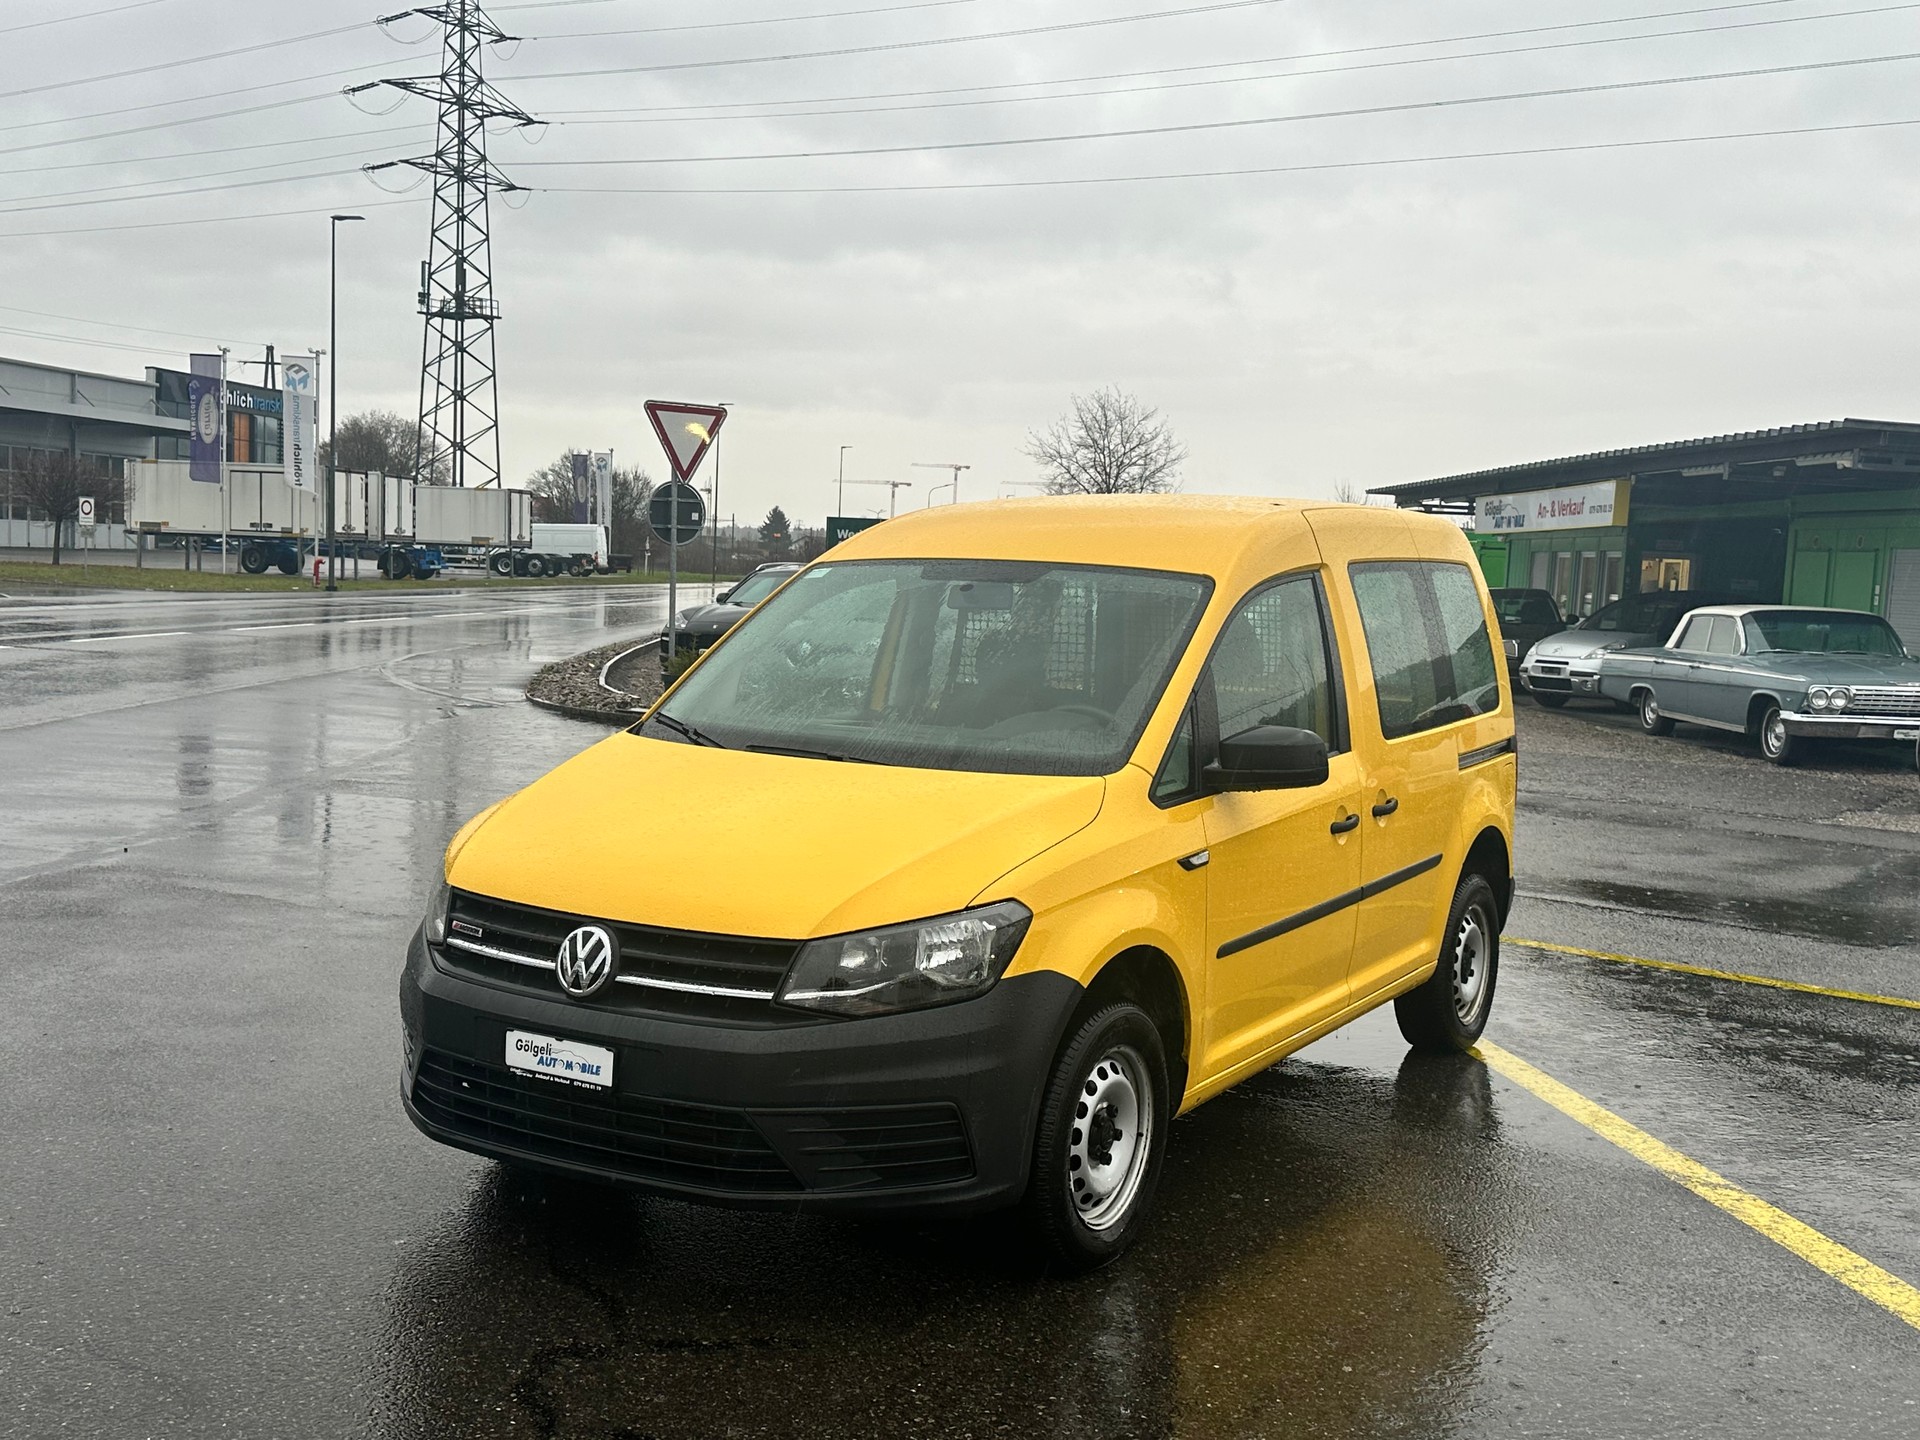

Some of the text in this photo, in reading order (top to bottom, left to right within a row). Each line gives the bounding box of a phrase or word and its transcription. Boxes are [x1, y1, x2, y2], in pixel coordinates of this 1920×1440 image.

[1537, 503, 1550, 519] An-
[1550, 503, 1556, 517] &
[1557, 496, 1586, 517] Verkauf
[515, 1038, 552, 1057] Gölgeli
[537, 1056, 602, 1076] AUTOMOBILE
